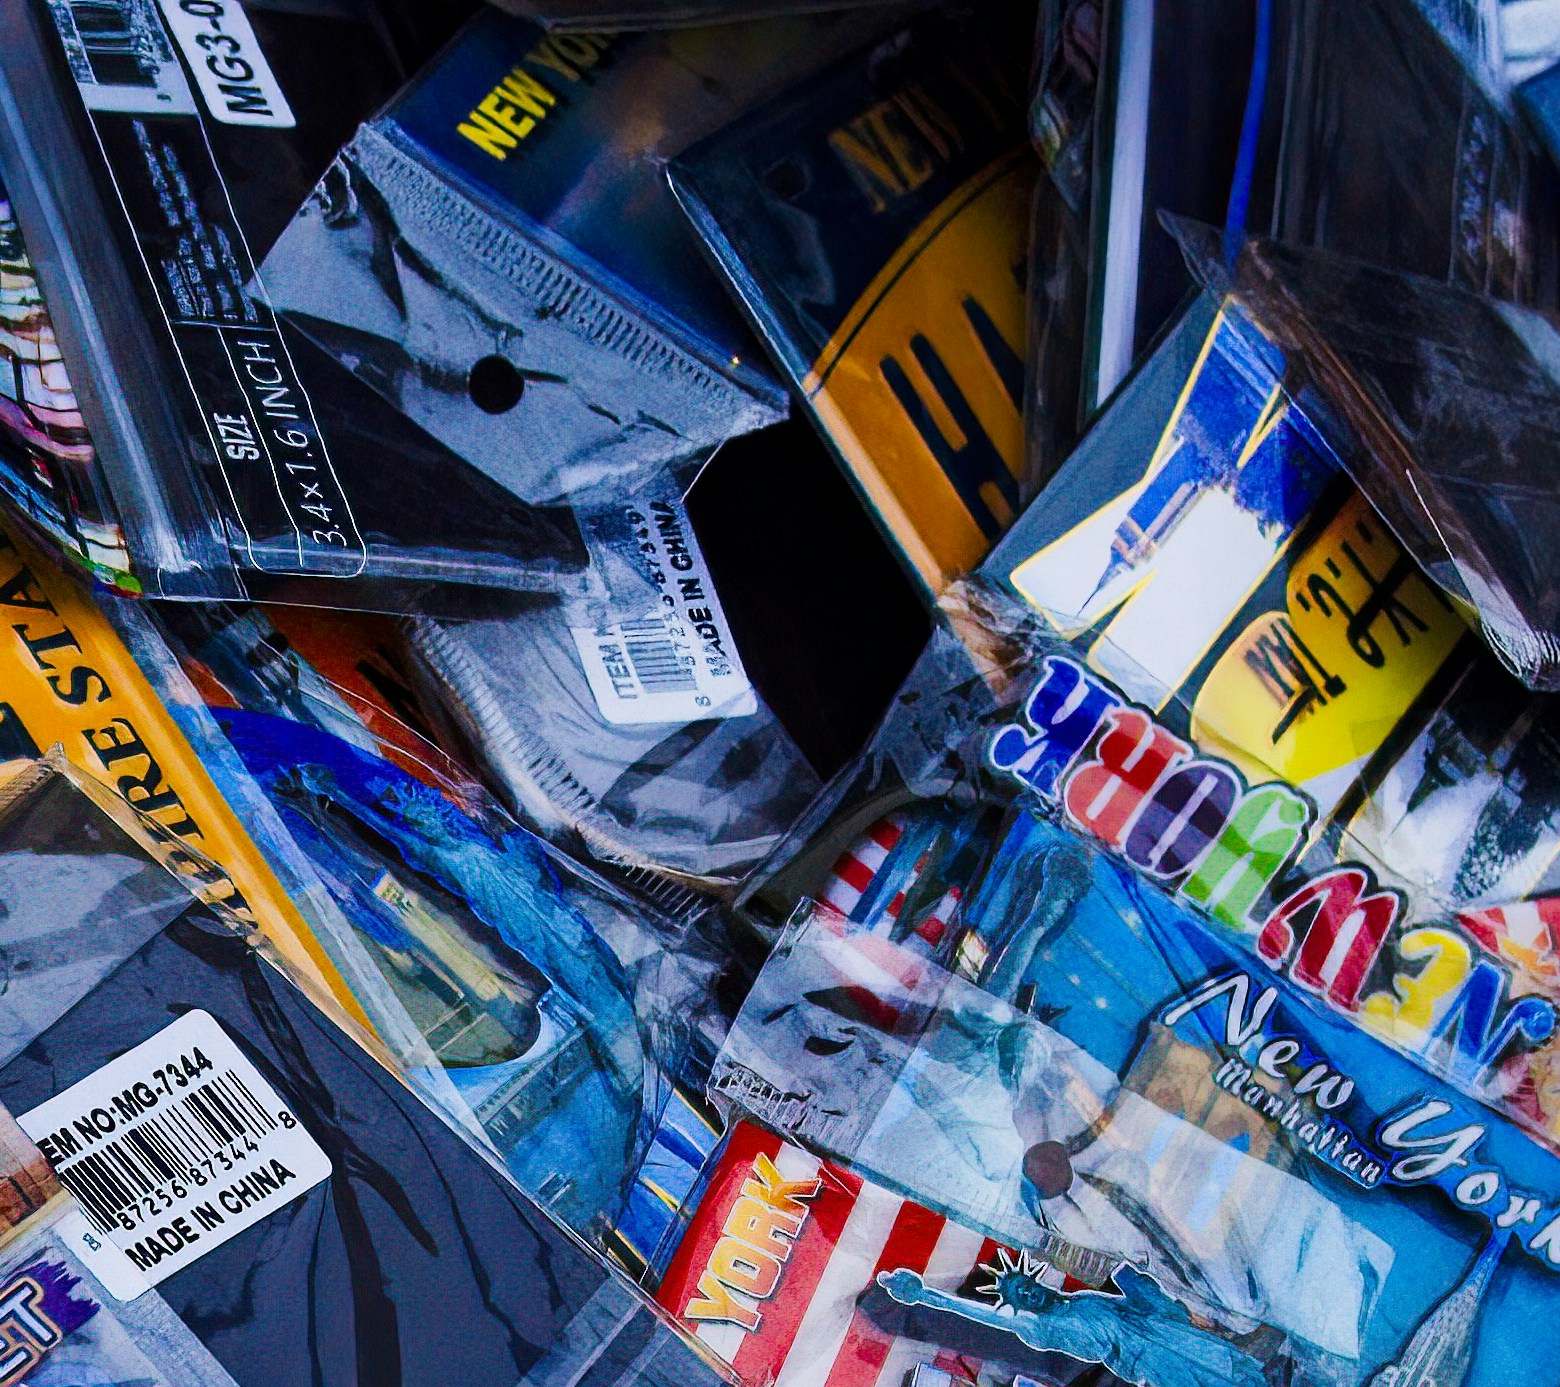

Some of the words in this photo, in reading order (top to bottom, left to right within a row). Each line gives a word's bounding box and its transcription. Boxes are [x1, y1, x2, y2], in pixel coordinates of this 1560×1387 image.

[458, 66, 558, 161] NEW
[253, 339, 291, 425] INCH
[225, 411, 260, 463] SIZE
[659, 499, 695, 573] CHINA
[1164, 970, 1357, 1112] New
[197, 1136, 259, 1186] 87344
[278, 1110, 297, 1131] 8
[1212, 1058, 1382, 1190] Manhattan
[124, 1222, 189, 1274] MADE
[192, 1200, 222, 1242] IN
[222, 1157, 297, 1216] CHINA
[683, 1153, 824, 1335] YORK
